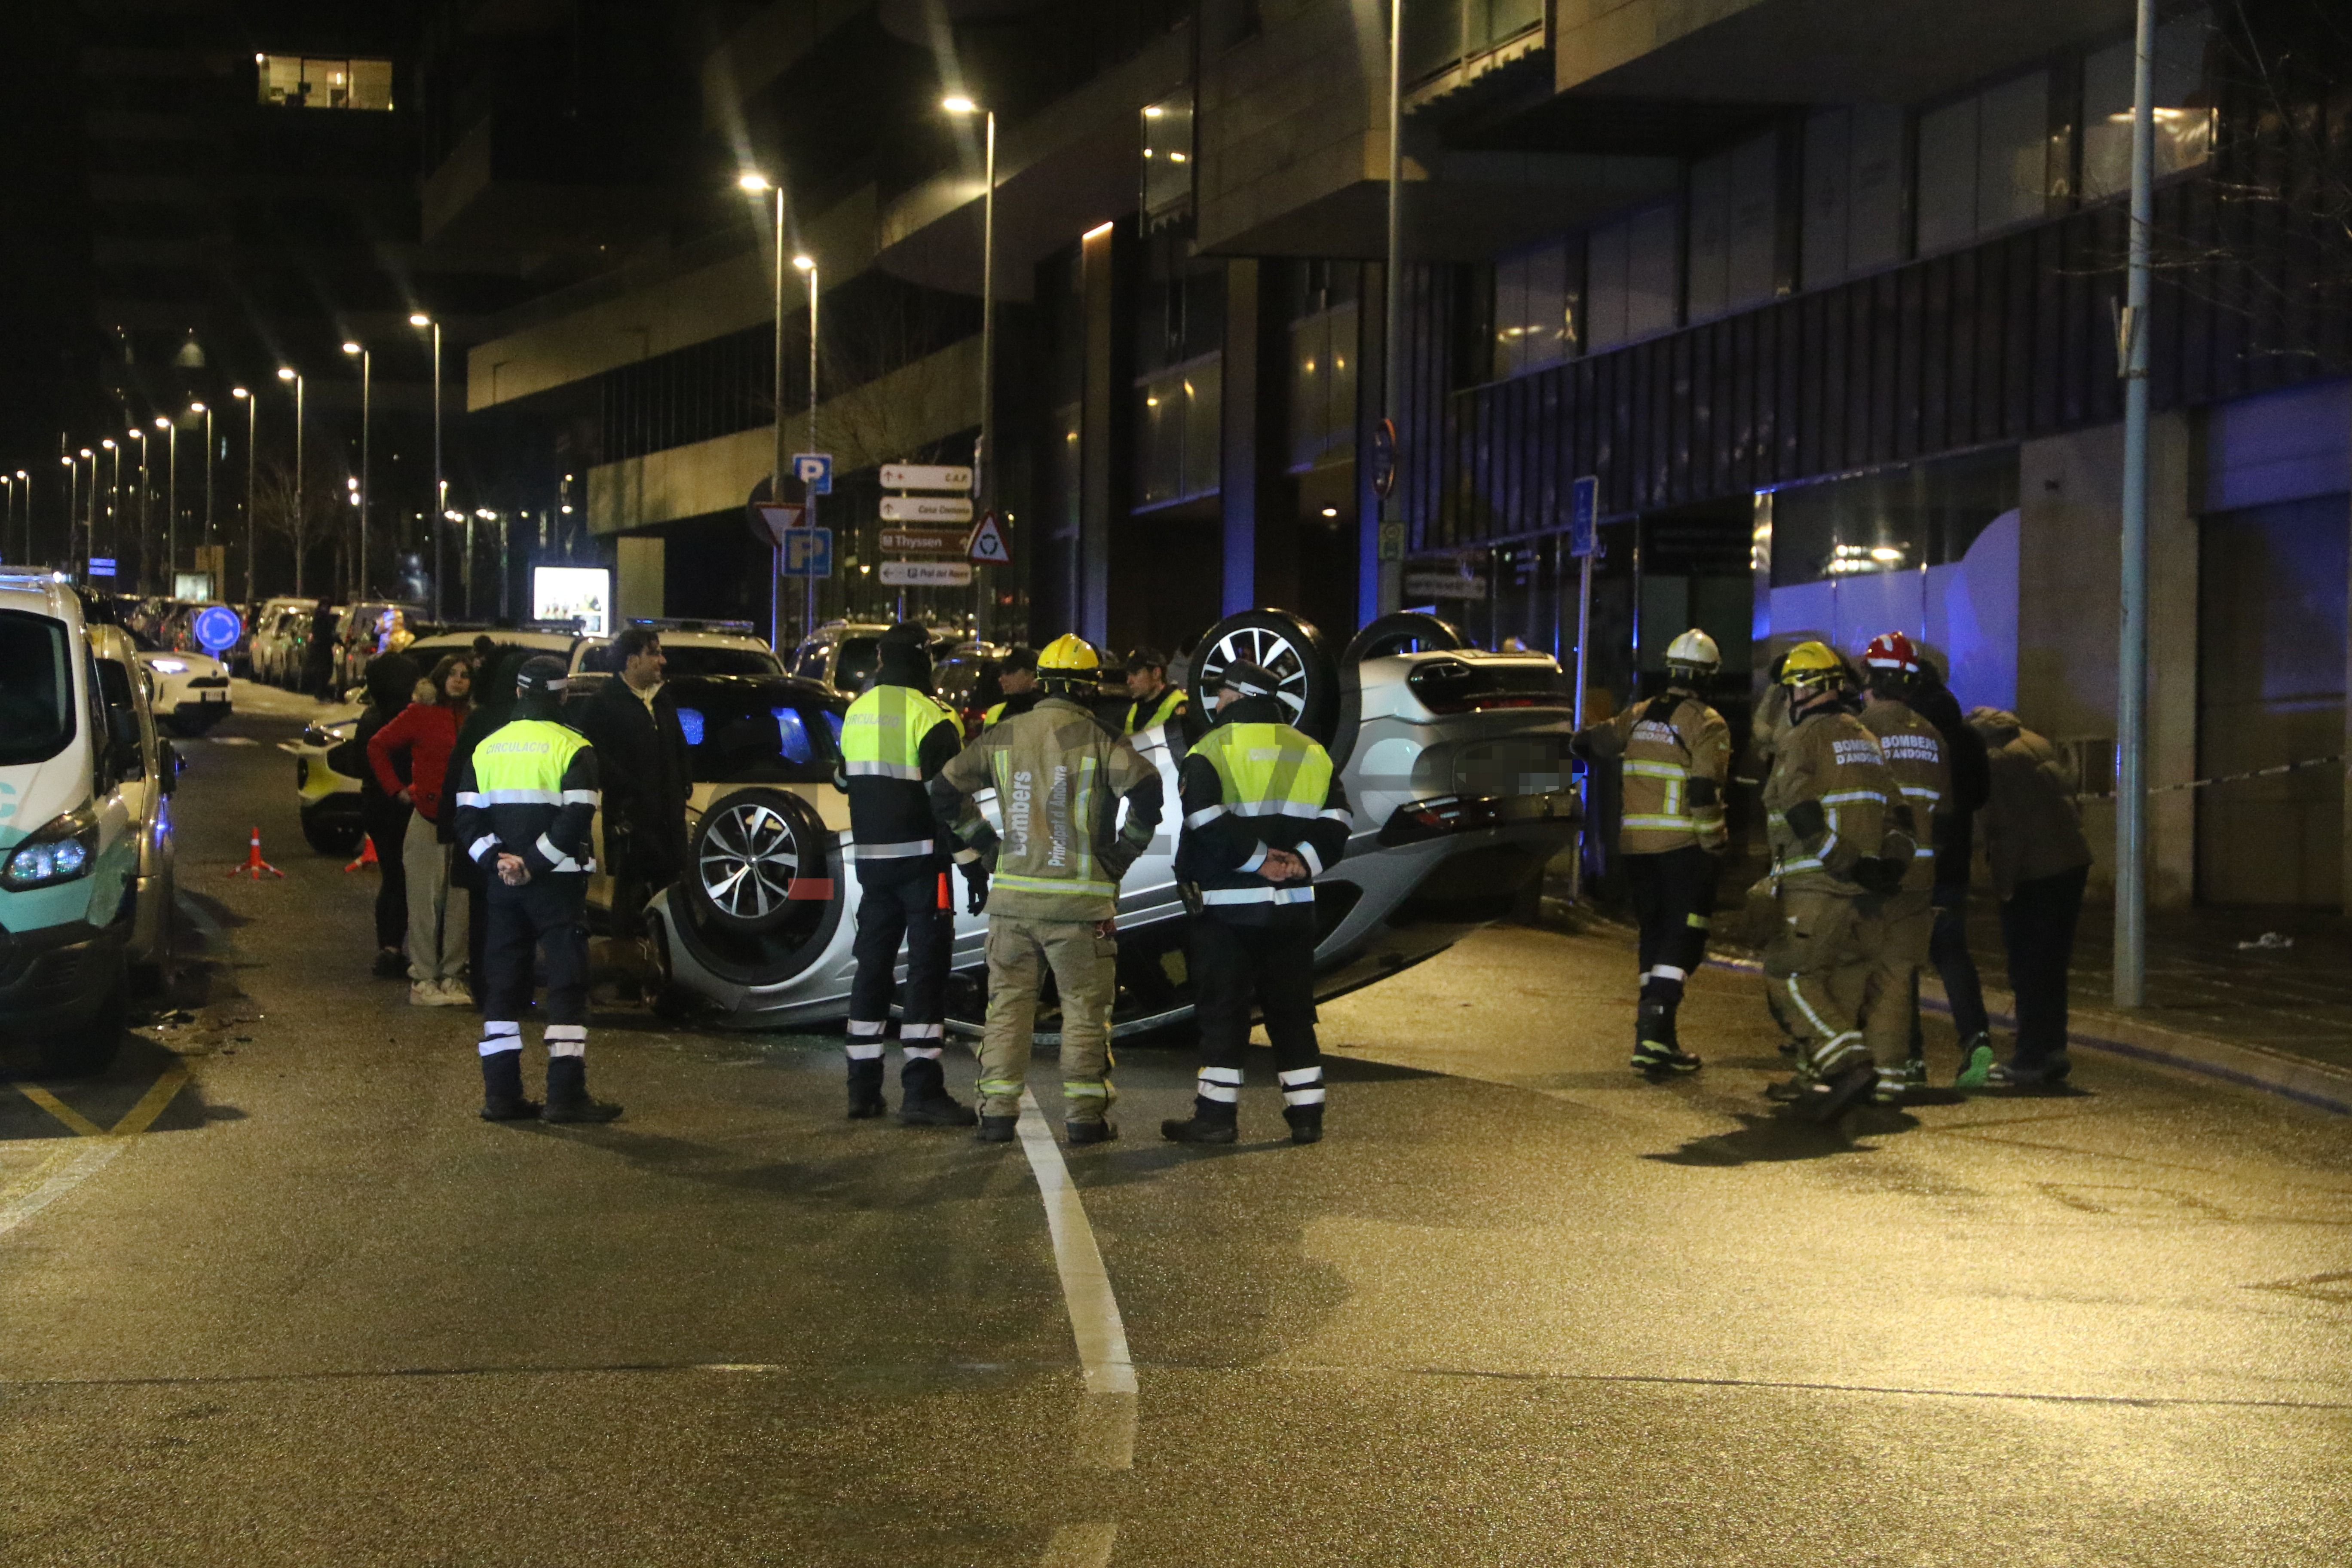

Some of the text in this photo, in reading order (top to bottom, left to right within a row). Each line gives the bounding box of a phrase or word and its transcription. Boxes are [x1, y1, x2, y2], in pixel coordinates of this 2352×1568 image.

[800, 459, 824, 483] P
[894, 534, 942, 549] Thyssen
[790, 536, 823, 569] P
[1832, 739, 1879, 753] BOMB
